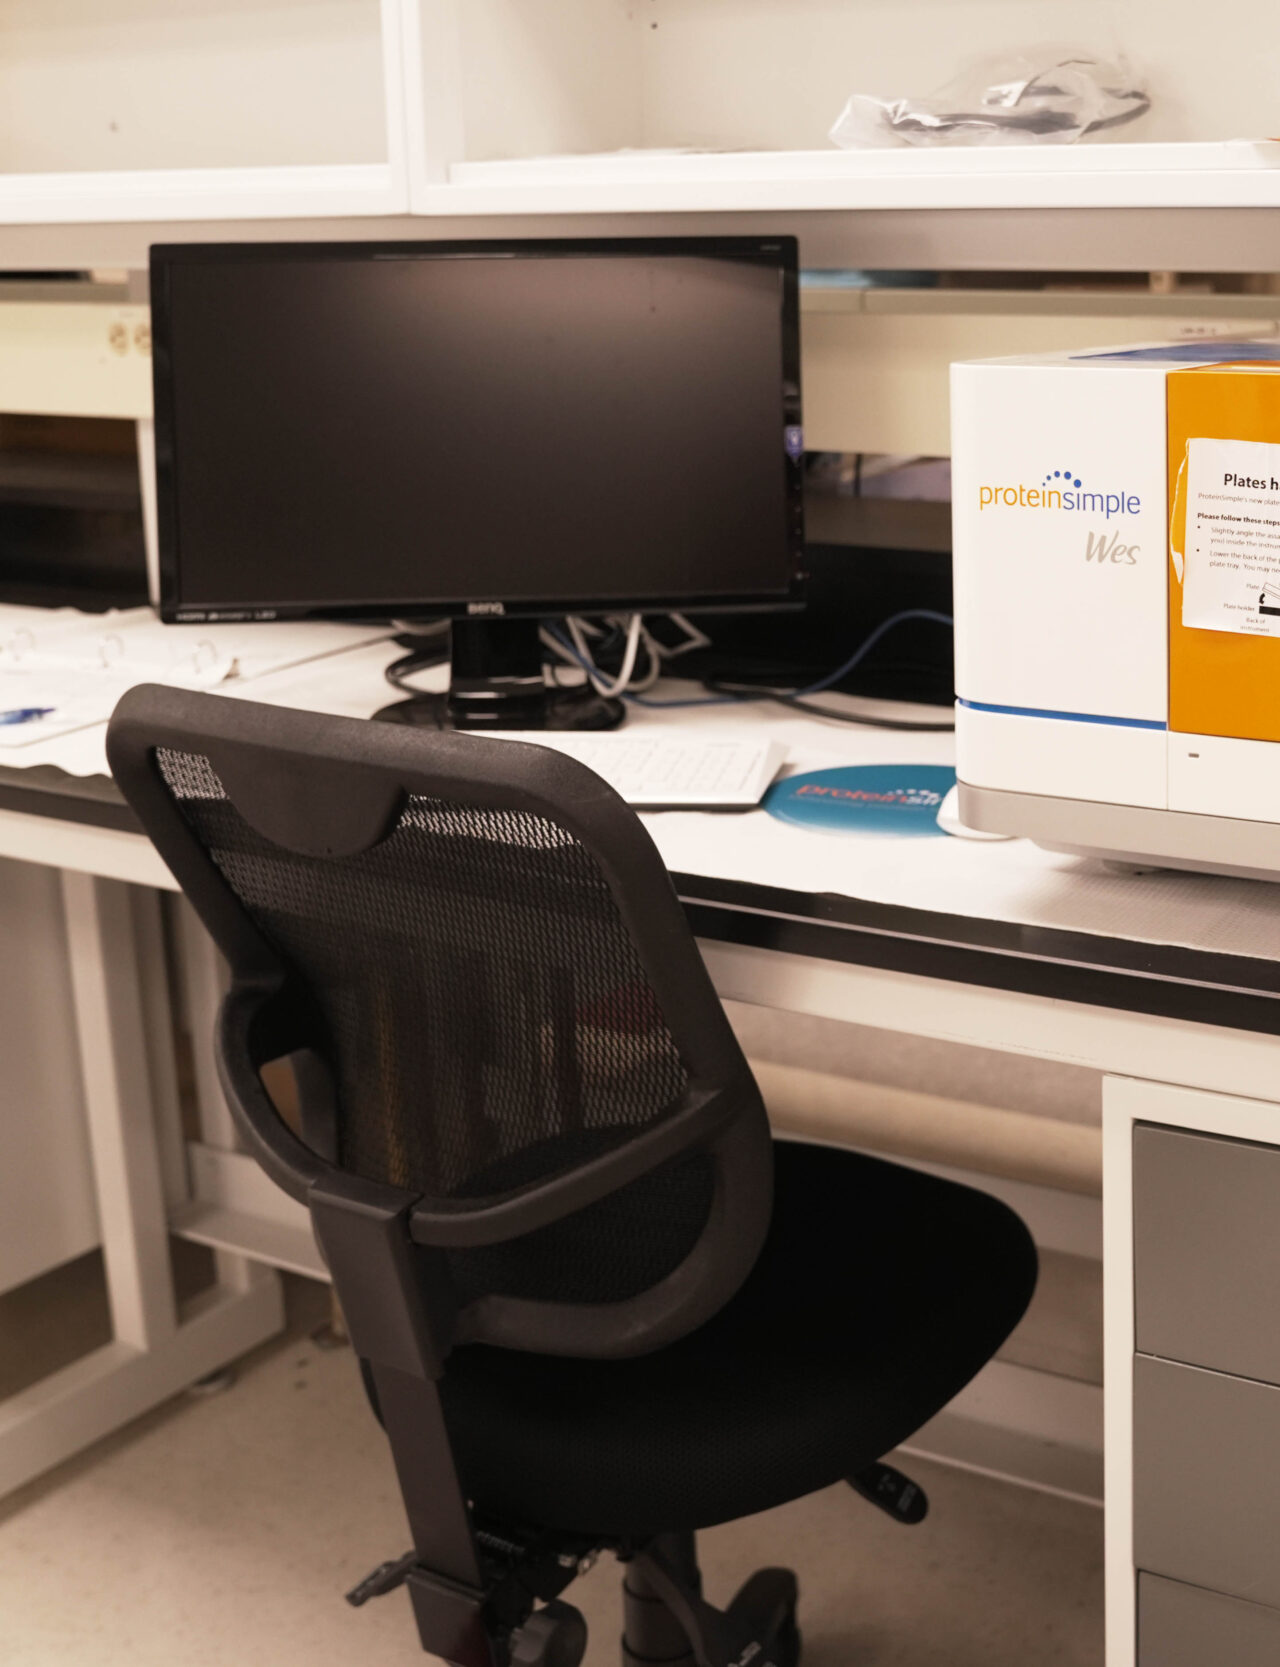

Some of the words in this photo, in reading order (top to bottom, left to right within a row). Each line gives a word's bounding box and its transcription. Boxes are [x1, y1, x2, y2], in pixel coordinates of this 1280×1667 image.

[1224, 474, 1266, 490] Plates
[979, 482, 1141, 519] proteinsimple
[1211, 527, 1234, 535] Slightly
[1085, 530, 1141, 565] Wes
[1243, 553, 1257, 561] back
[1210, 560, 1226, 568] plate
